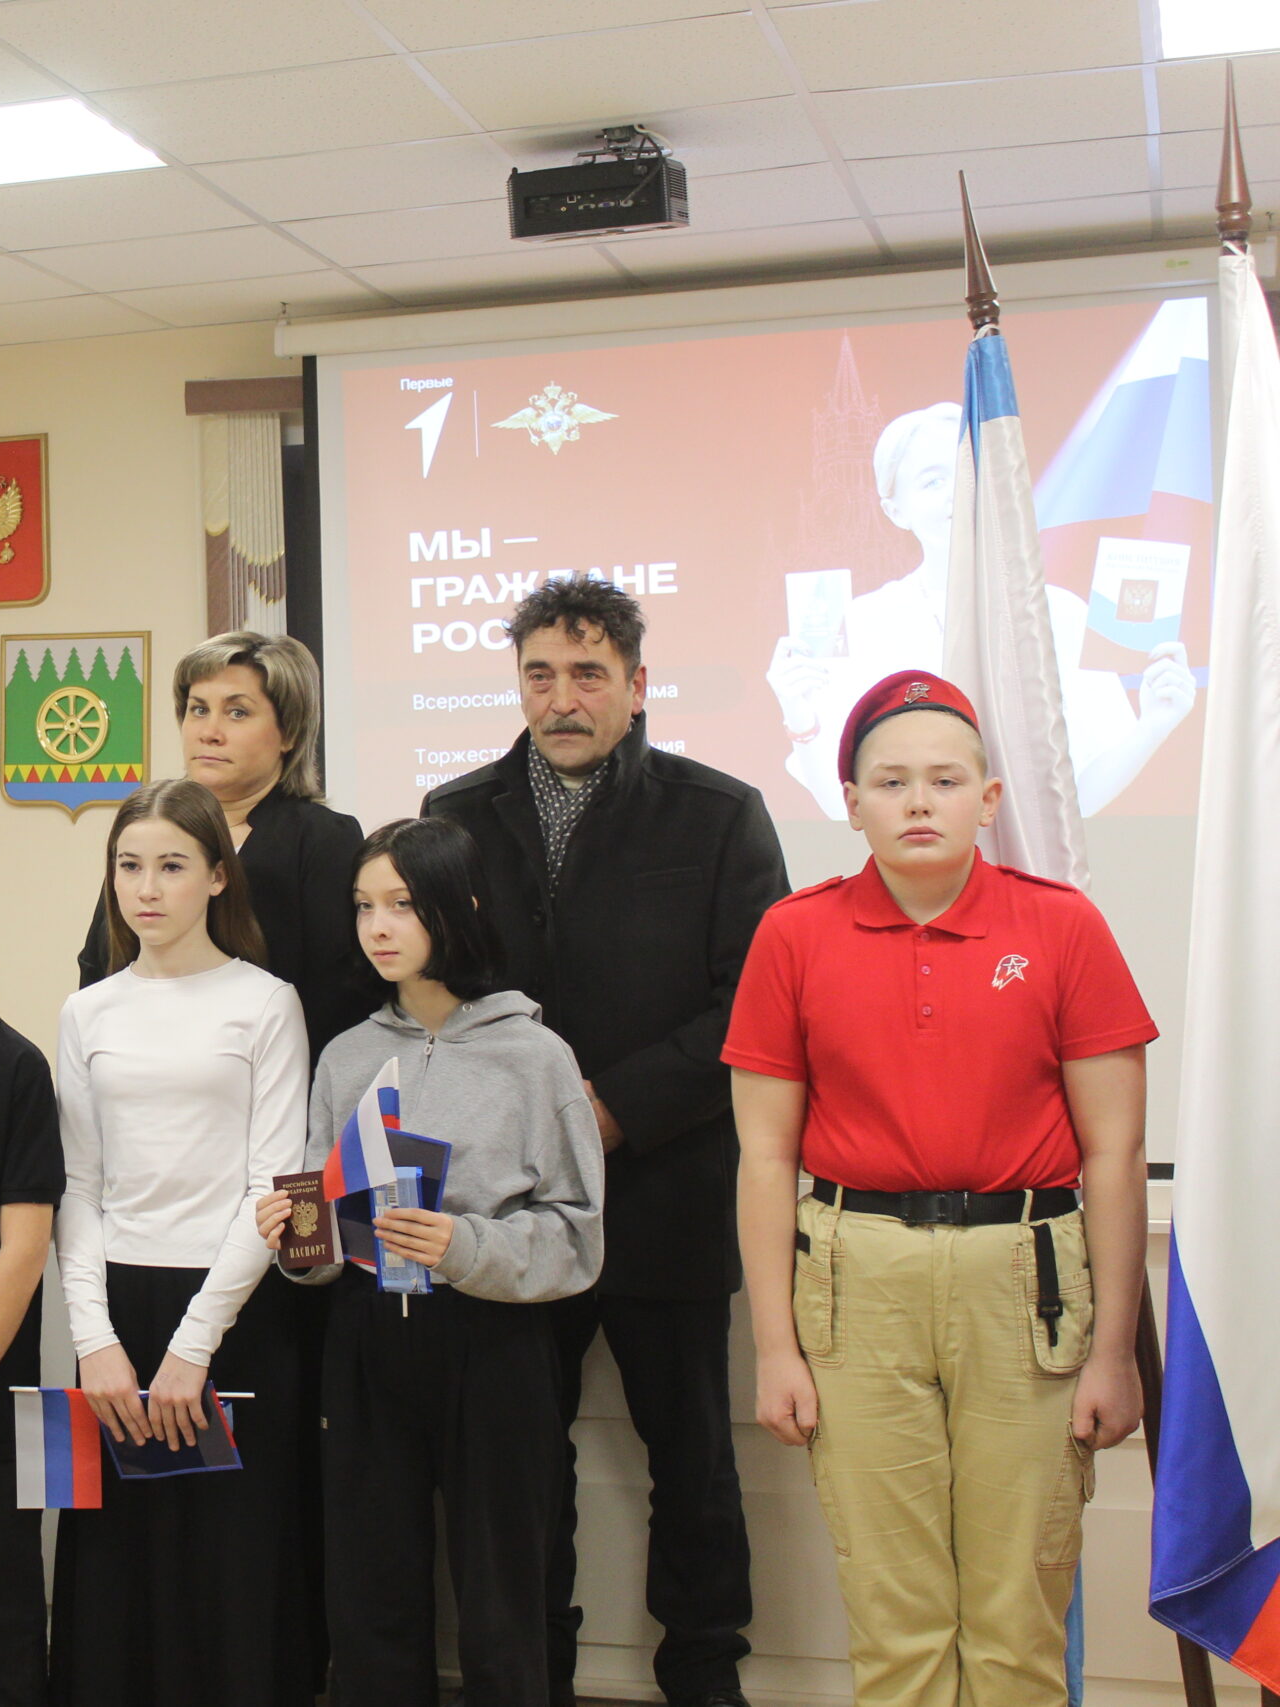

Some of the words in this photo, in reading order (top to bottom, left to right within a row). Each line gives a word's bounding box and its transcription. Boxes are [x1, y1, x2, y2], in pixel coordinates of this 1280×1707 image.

[400, 377, 453, 392] Первые
[409, 528, 491, 562] МЫ
[411, 563, 677, 608] ГРАЖНЕ
[413, 619, 512, 653] РОС
[412, 690, 521, 712] Всероссий
[289, 1244, 326, 1259] ПАСПОРТ
